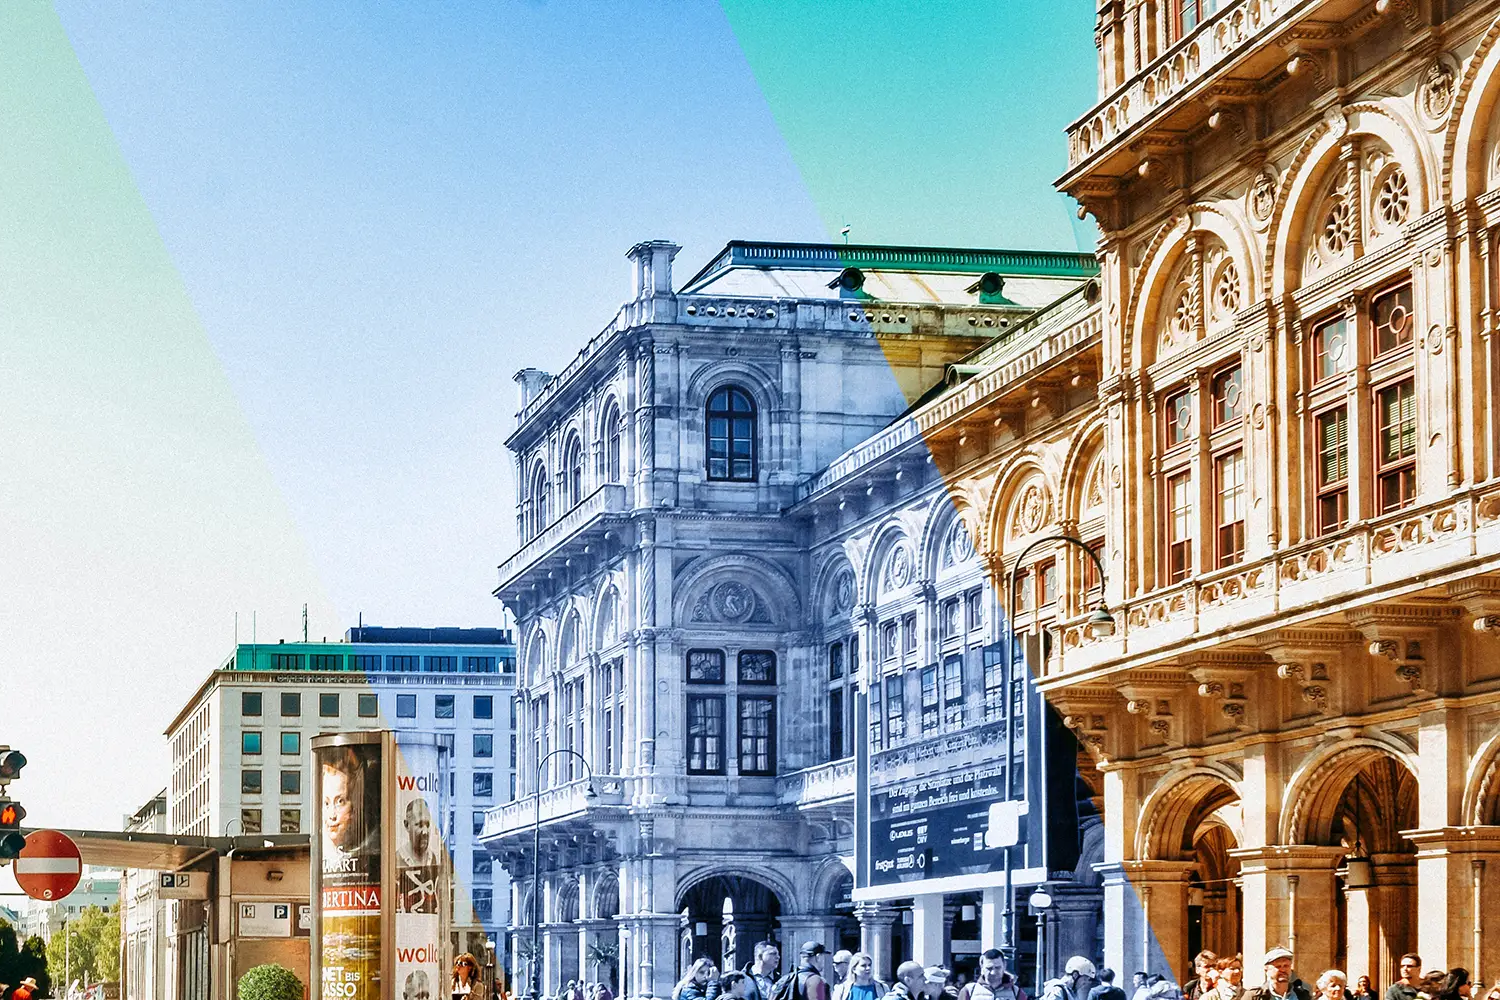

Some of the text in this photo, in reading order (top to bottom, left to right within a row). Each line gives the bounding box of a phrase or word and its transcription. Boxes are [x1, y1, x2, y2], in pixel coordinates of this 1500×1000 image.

[888, 787, 898, 798] Der
[928, 793, 948, 806] Bereich
[948, 791, 958, 802] frei
[958, 788, 970, 800] und
[163, 875, 172, 886] P
[277, 909, 285, 918] P
[345, 972, 360, 981] BIS
